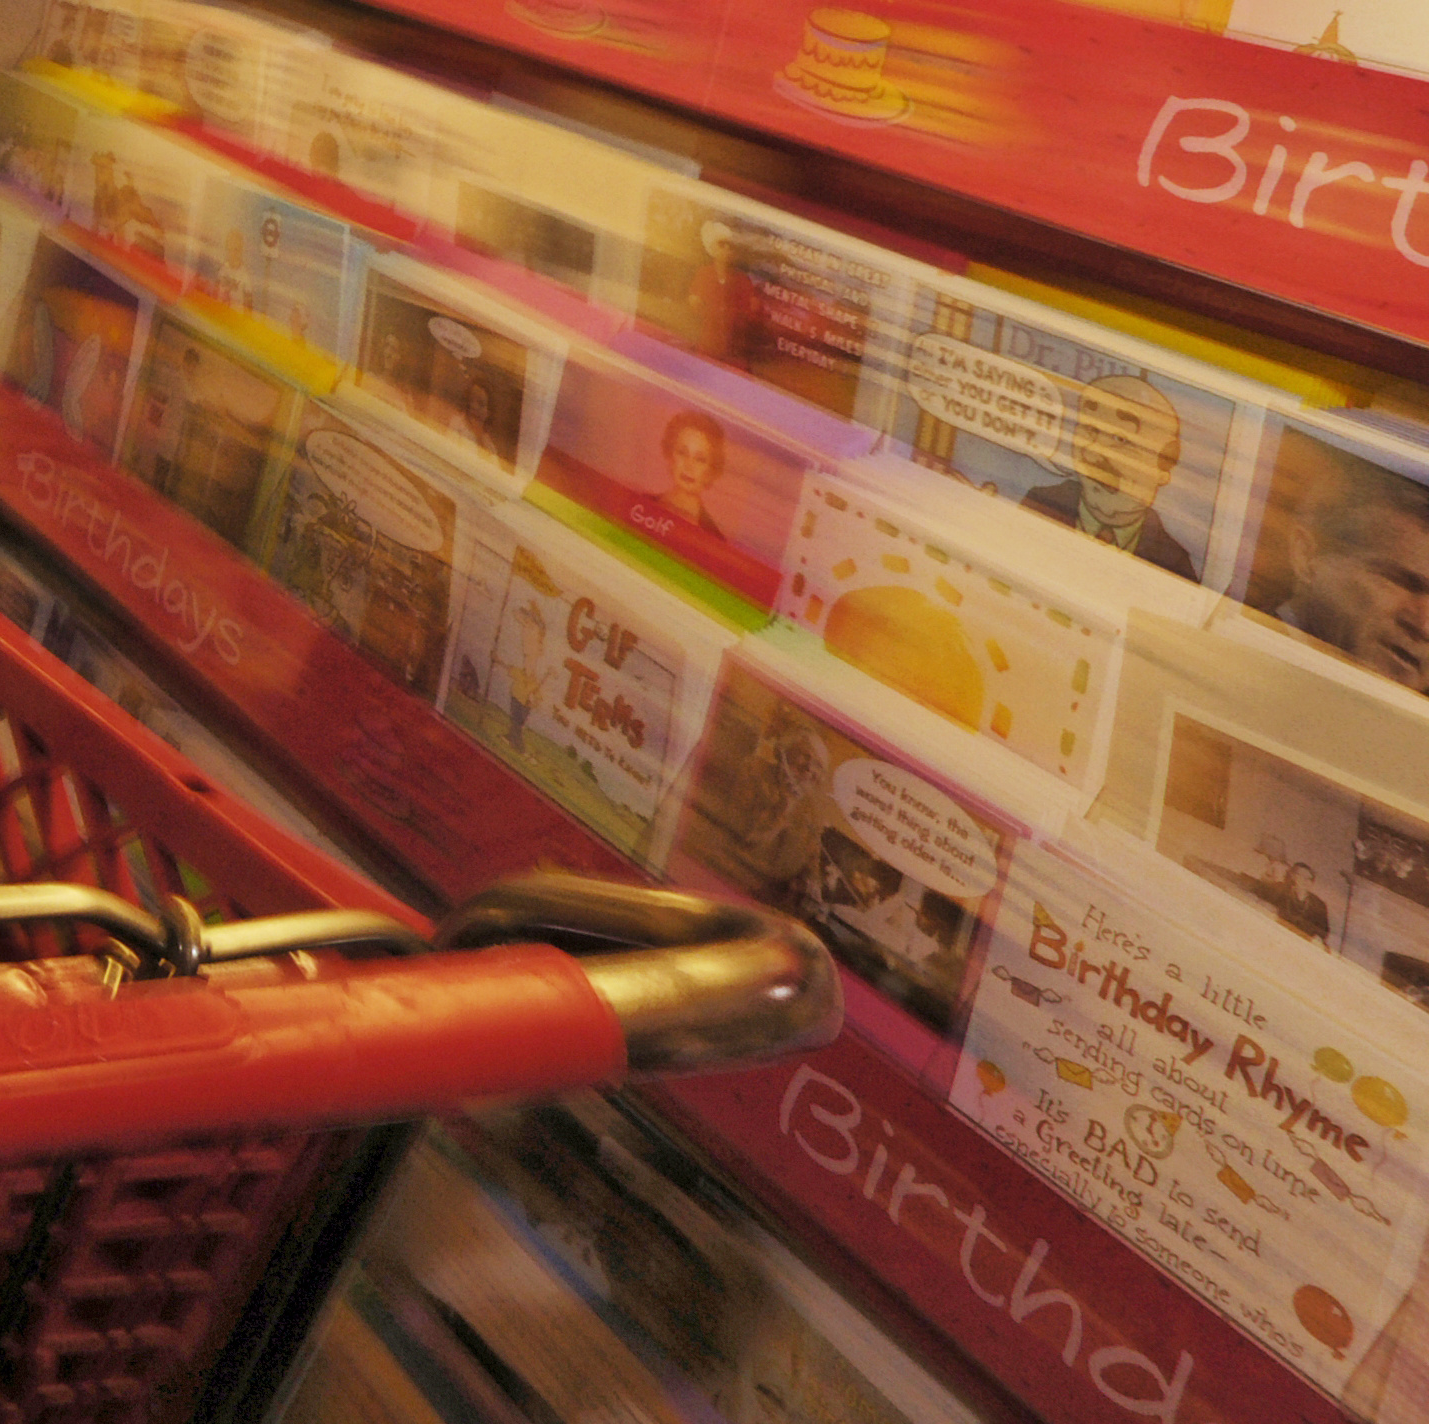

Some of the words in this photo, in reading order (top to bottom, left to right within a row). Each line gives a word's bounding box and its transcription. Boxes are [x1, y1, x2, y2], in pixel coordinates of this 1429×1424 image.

[14, 450, 243, 668] Birthdays
[628, 502, 676, 538] Golf
[1028, 921, 1215, 1066] Birthday
[1224, 1033, 1371, 1163] Rhyme
[1165, 963, 1183, 983] a
[1199, 975, 1268, 1030] little
[1046, 1018, 1142, 1097] sending
[1150, 1086, 1218, 1137] cards
[1222, 1131, 1255, 1167] on
[1096, 1021, 1139, 1057] all
[1151, 1056, 1229, 1116] about
[1012, 1107, 1026, 1126] a
[1035, 1119, 1143, 1220] Greeting
[1084, 1118, 1158, 1187] BAD
[1168, 1179, 1193, 1208] to
[1203, 1206, 1262, 1257] send
[1134, 1227, 1232, 1305] someone
